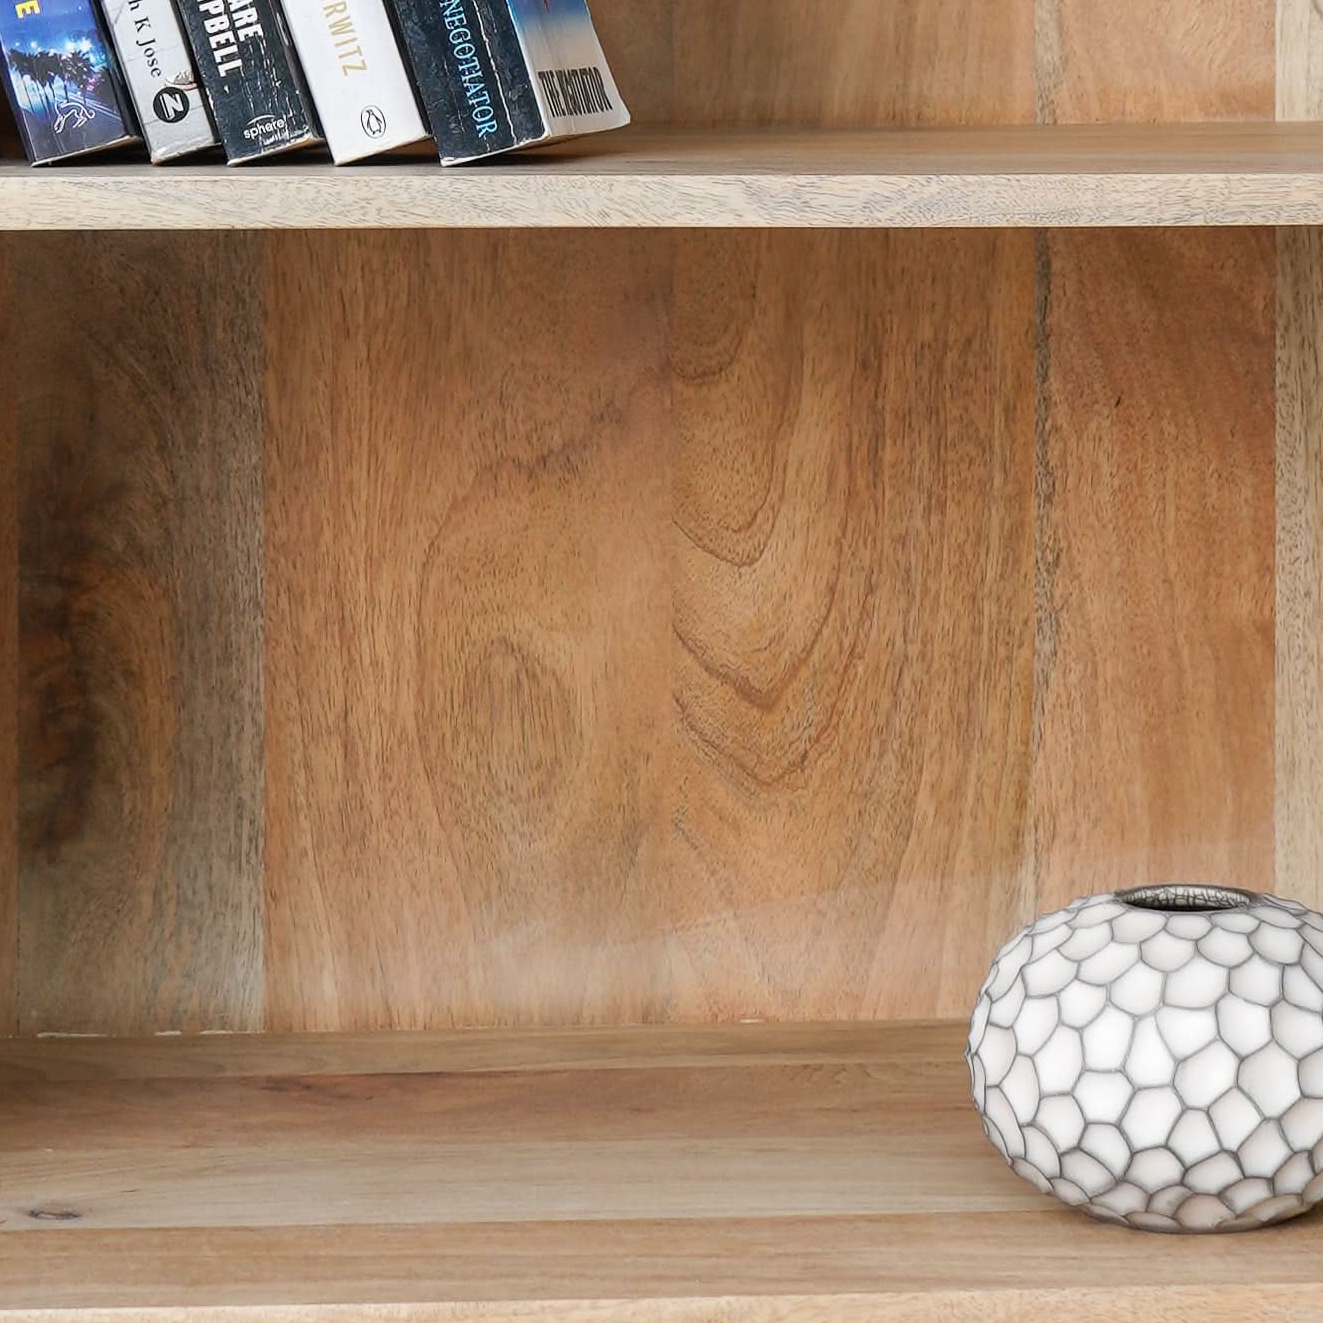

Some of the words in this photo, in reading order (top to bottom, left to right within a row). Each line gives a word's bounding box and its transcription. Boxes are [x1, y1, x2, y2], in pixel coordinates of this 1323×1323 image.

[133, 16, 152, 33] K
[136, 38, 162, 78] Jose
[538, 68, 566, 118] THE
[243, 118, 285, 140] sphere
